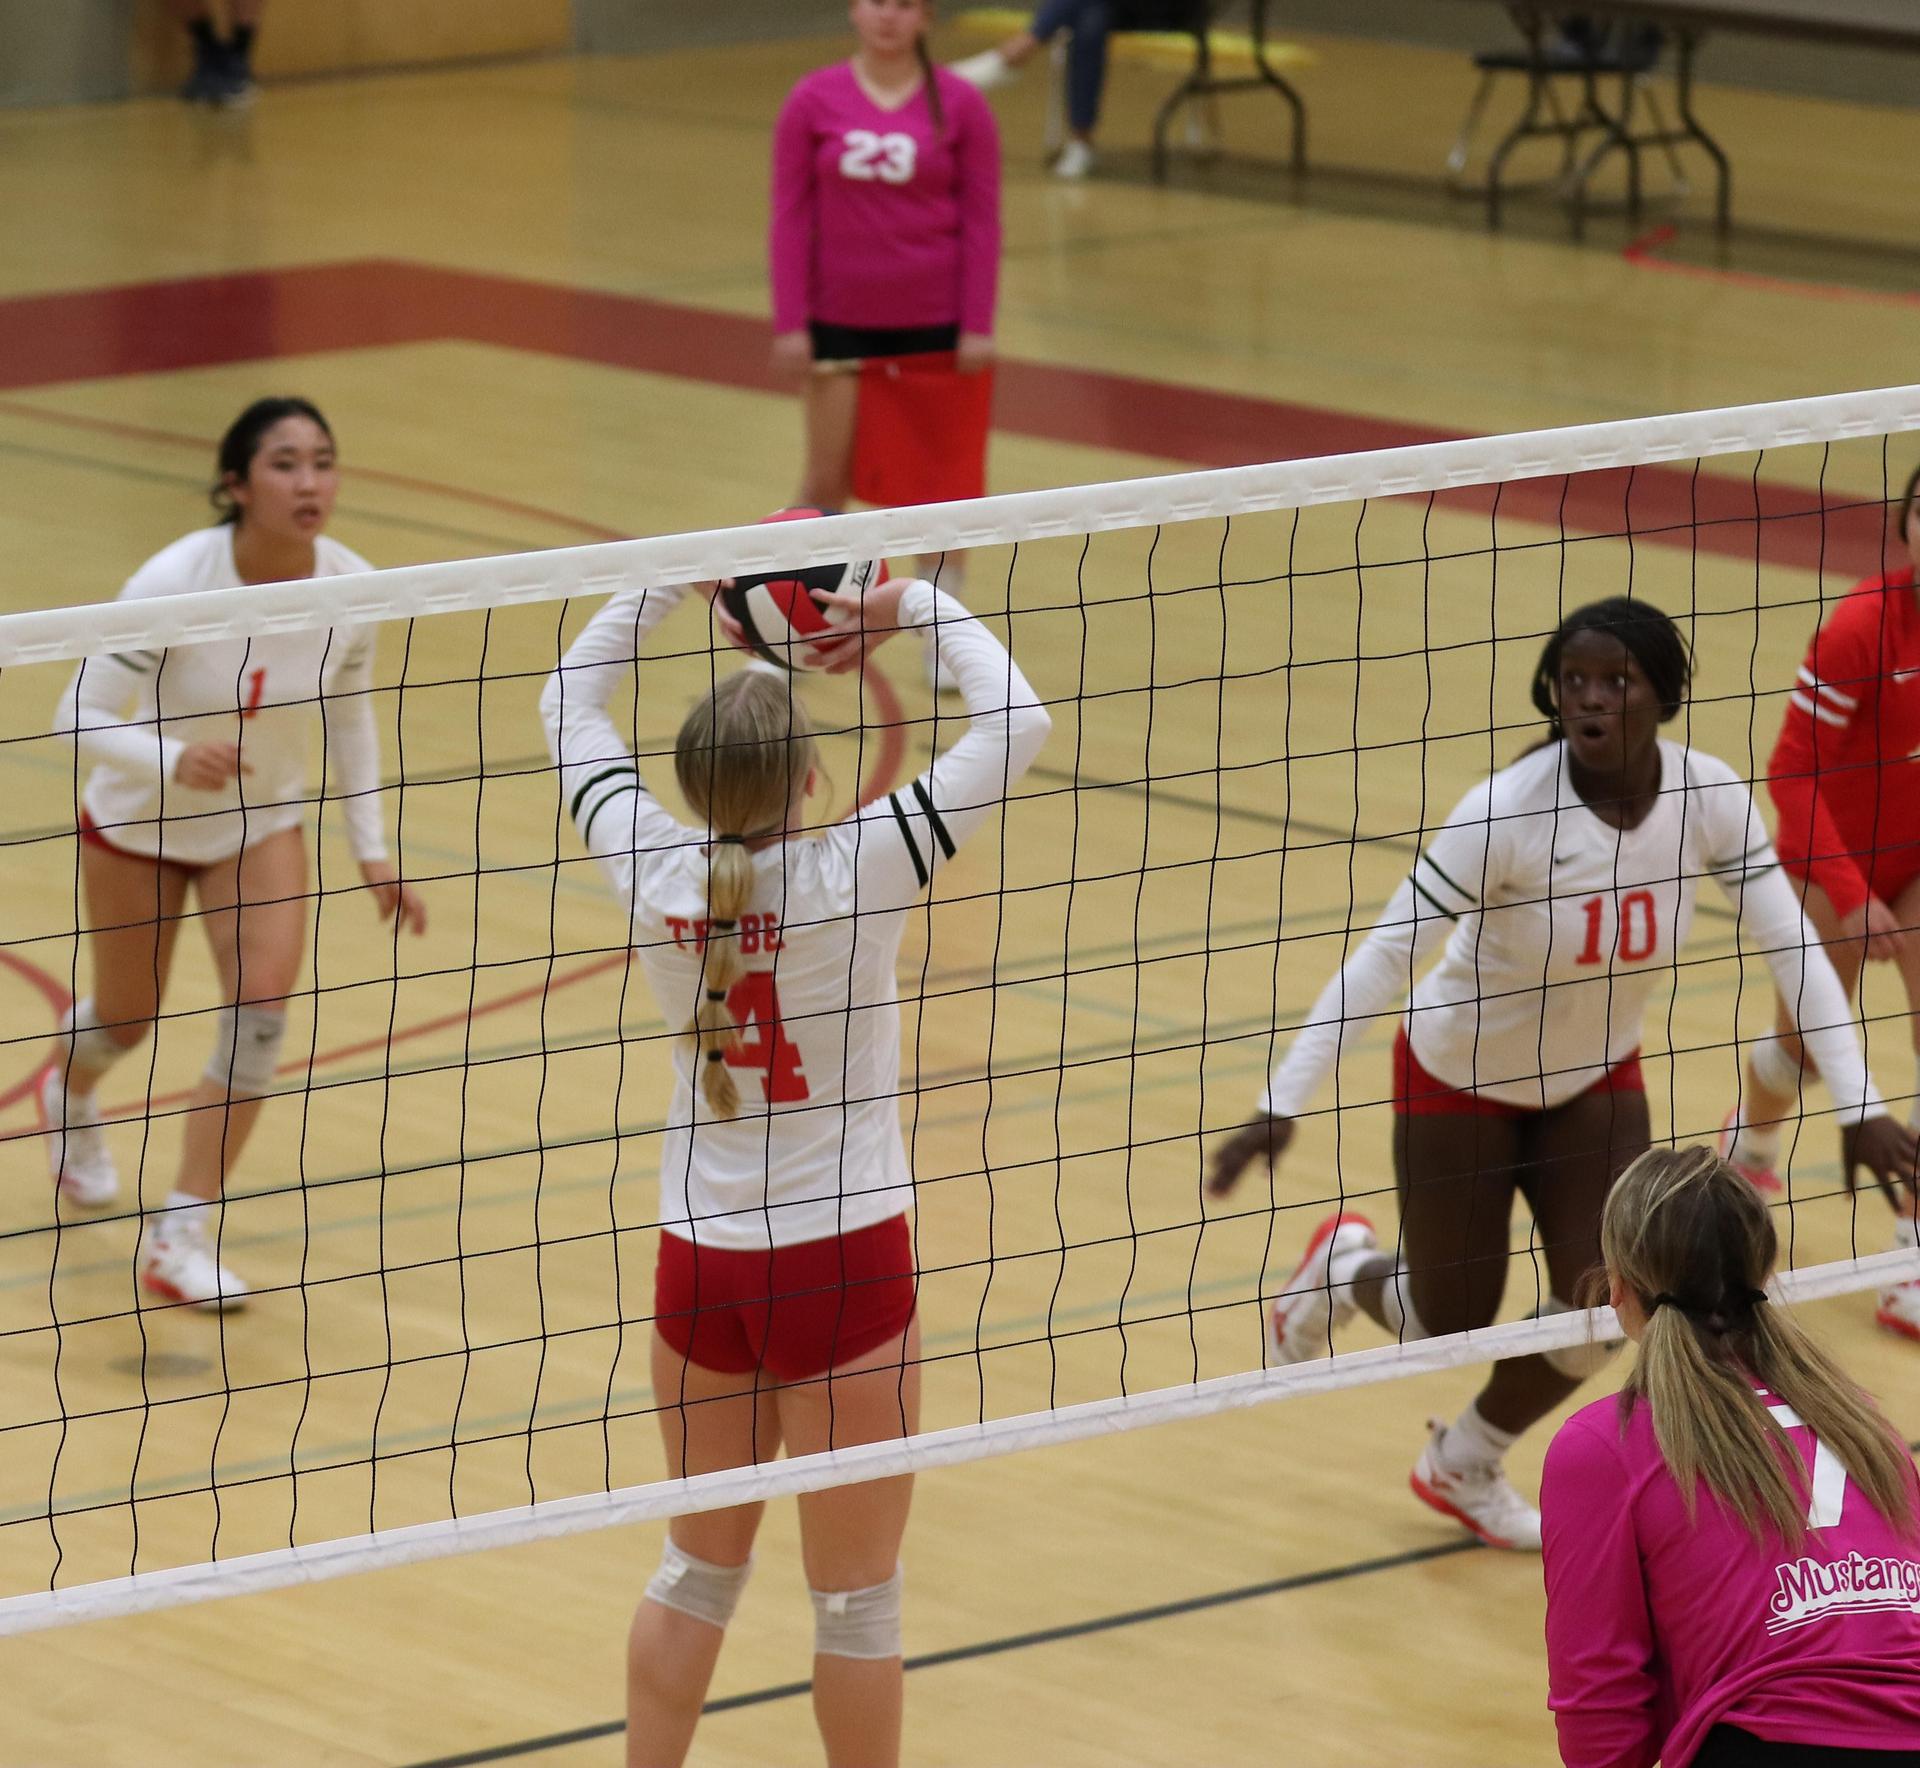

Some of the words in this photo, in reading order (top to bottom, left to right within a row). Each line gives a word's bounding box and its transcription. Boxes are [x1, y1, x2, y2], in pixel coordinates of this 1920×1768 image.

[839, 129, 917, 184] 23
[239, 667, 266, 719] 1
[1575, 889, 1657, 965] 10
[723, 970, 809, 1103] 4
[1766, 1404, 1847, 1529] 7
[1771, 1552, 1920, 1614] Mustang
